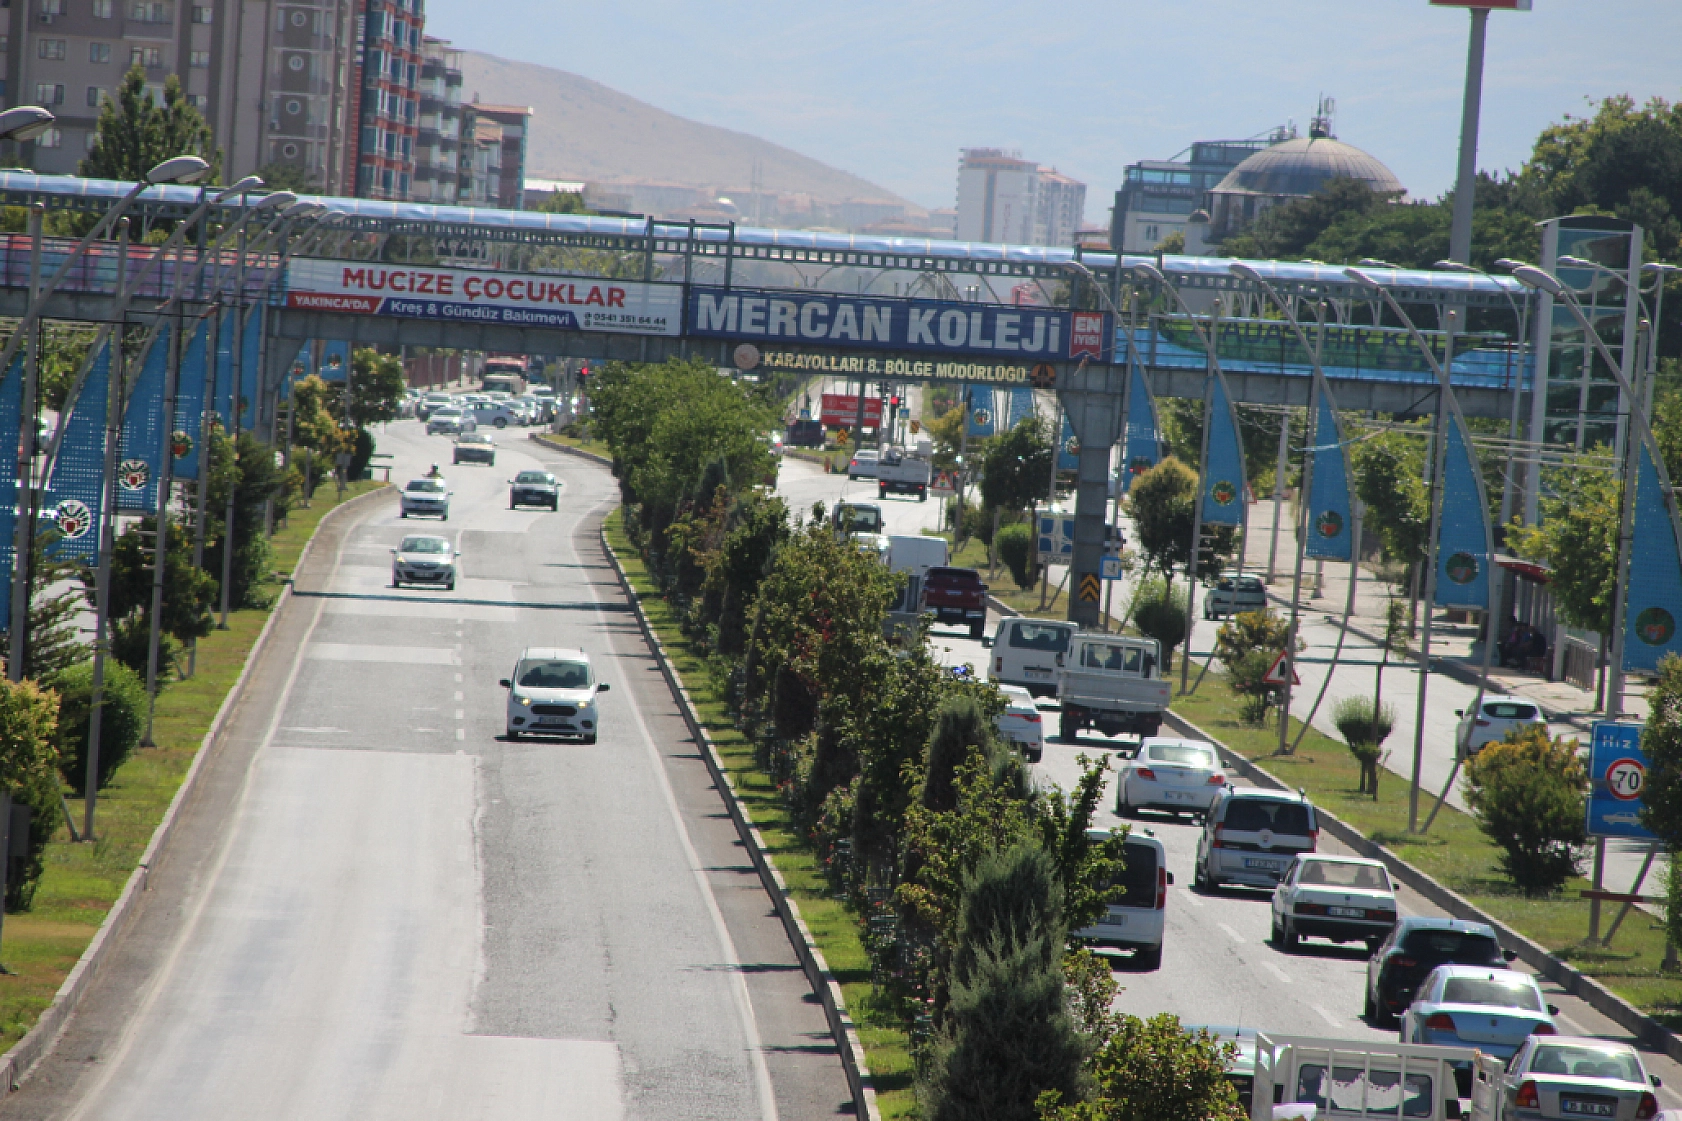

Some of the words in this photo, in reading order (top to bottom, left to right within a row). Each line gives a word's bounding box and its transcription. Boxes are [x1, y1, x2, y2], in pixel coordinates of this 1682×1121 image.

[295, 295, 371, 310] YAKINCA'DA
[463, 276, 626, 308] ÇOCUKLAR
[391, 300, 423, 316] Kreş
[426, 303, 438, 315] &
[442, 304, 499, 319] Gündüz
[502, 308, 570, 325] Bakımevi
[697, 293, 892, 342] MERCAN
[1074, 316, 1101, 333] EN
[764, 350, 864, 371] KARAYOLLARI
[867, 358, 880, 373] 8.
[885, 357, 933, 377] BÖLGE
[1615, 770, 1640, 790] 70
